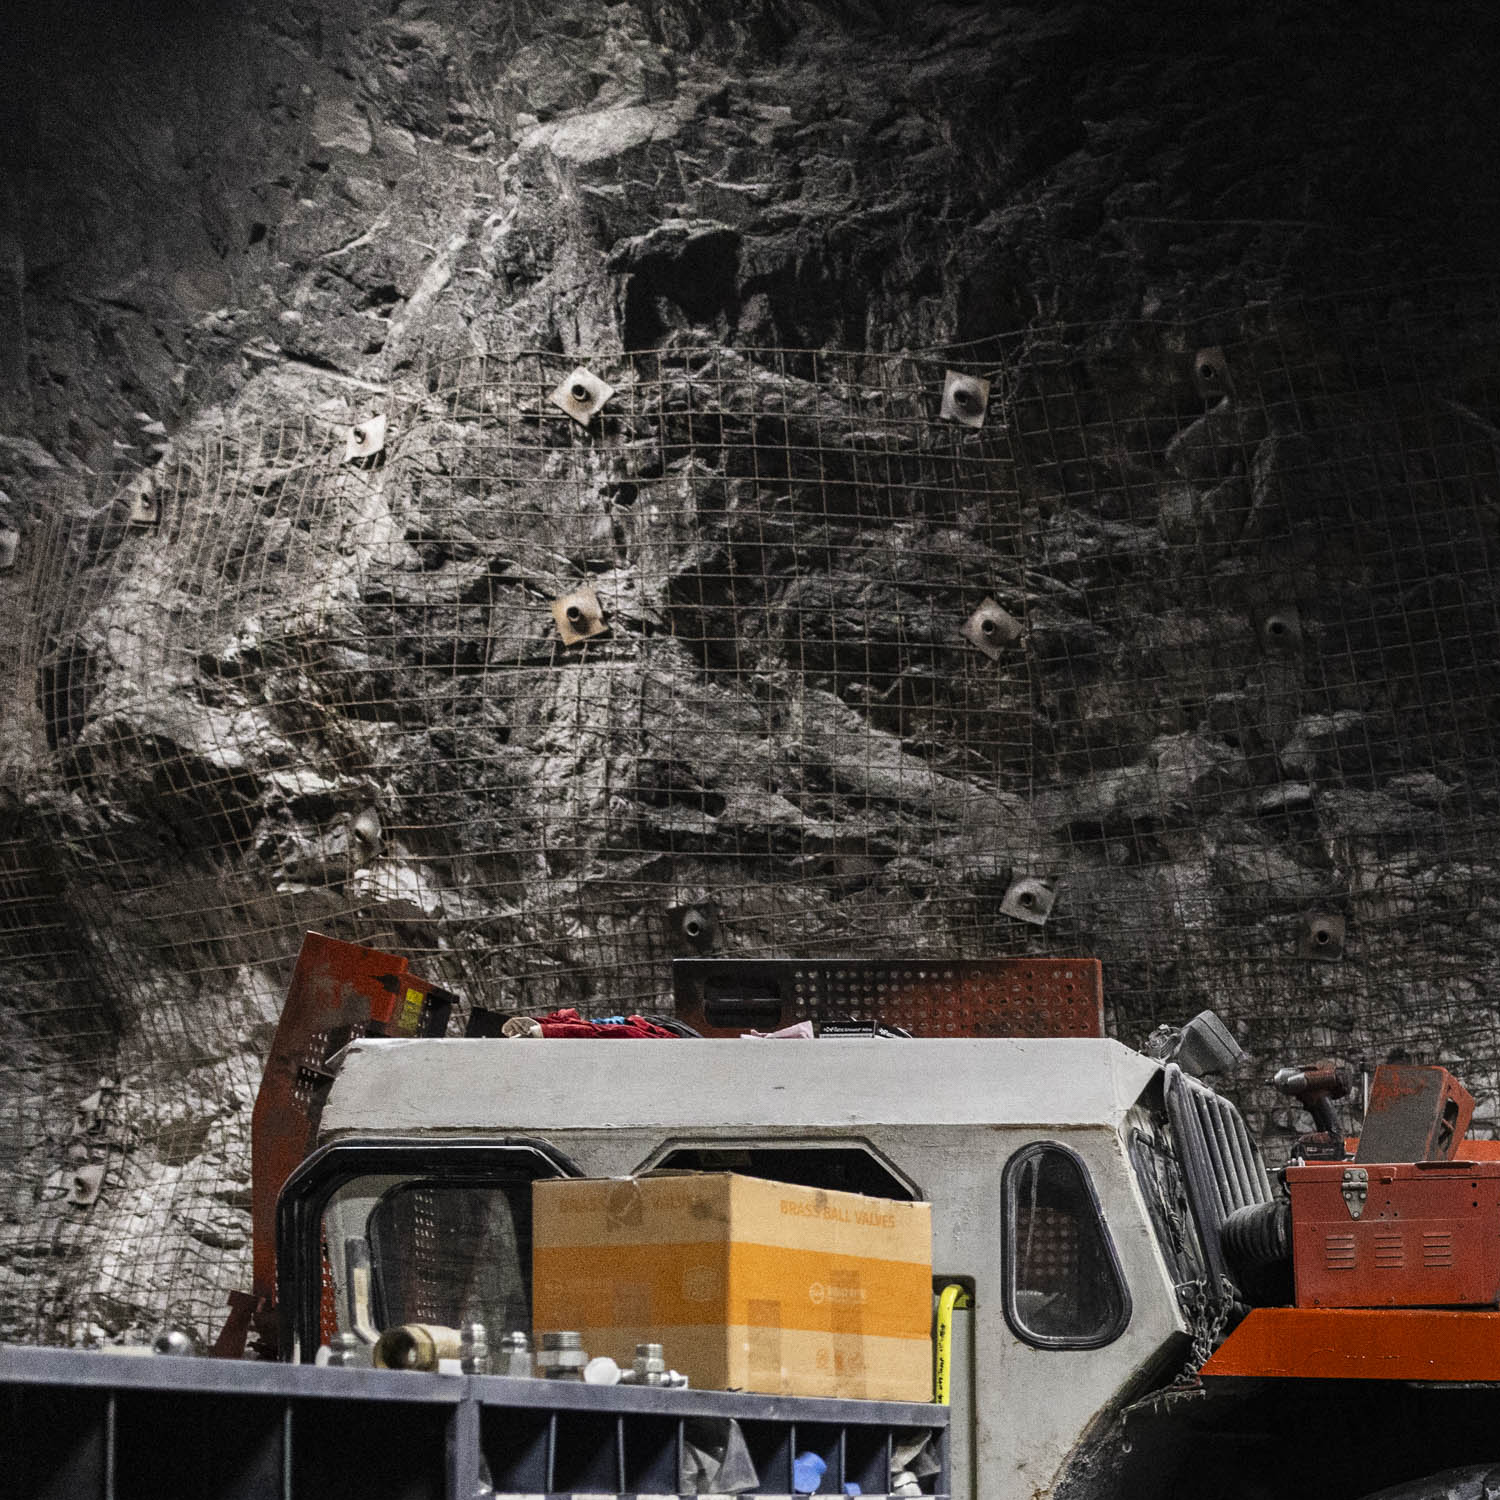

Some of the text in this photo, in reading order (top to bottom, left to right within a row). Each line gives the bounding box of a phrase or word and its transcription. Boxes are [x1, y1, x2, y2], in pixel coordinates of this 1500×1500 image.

[780, 1199, 896, 1229] BRASS BALL VALVES
